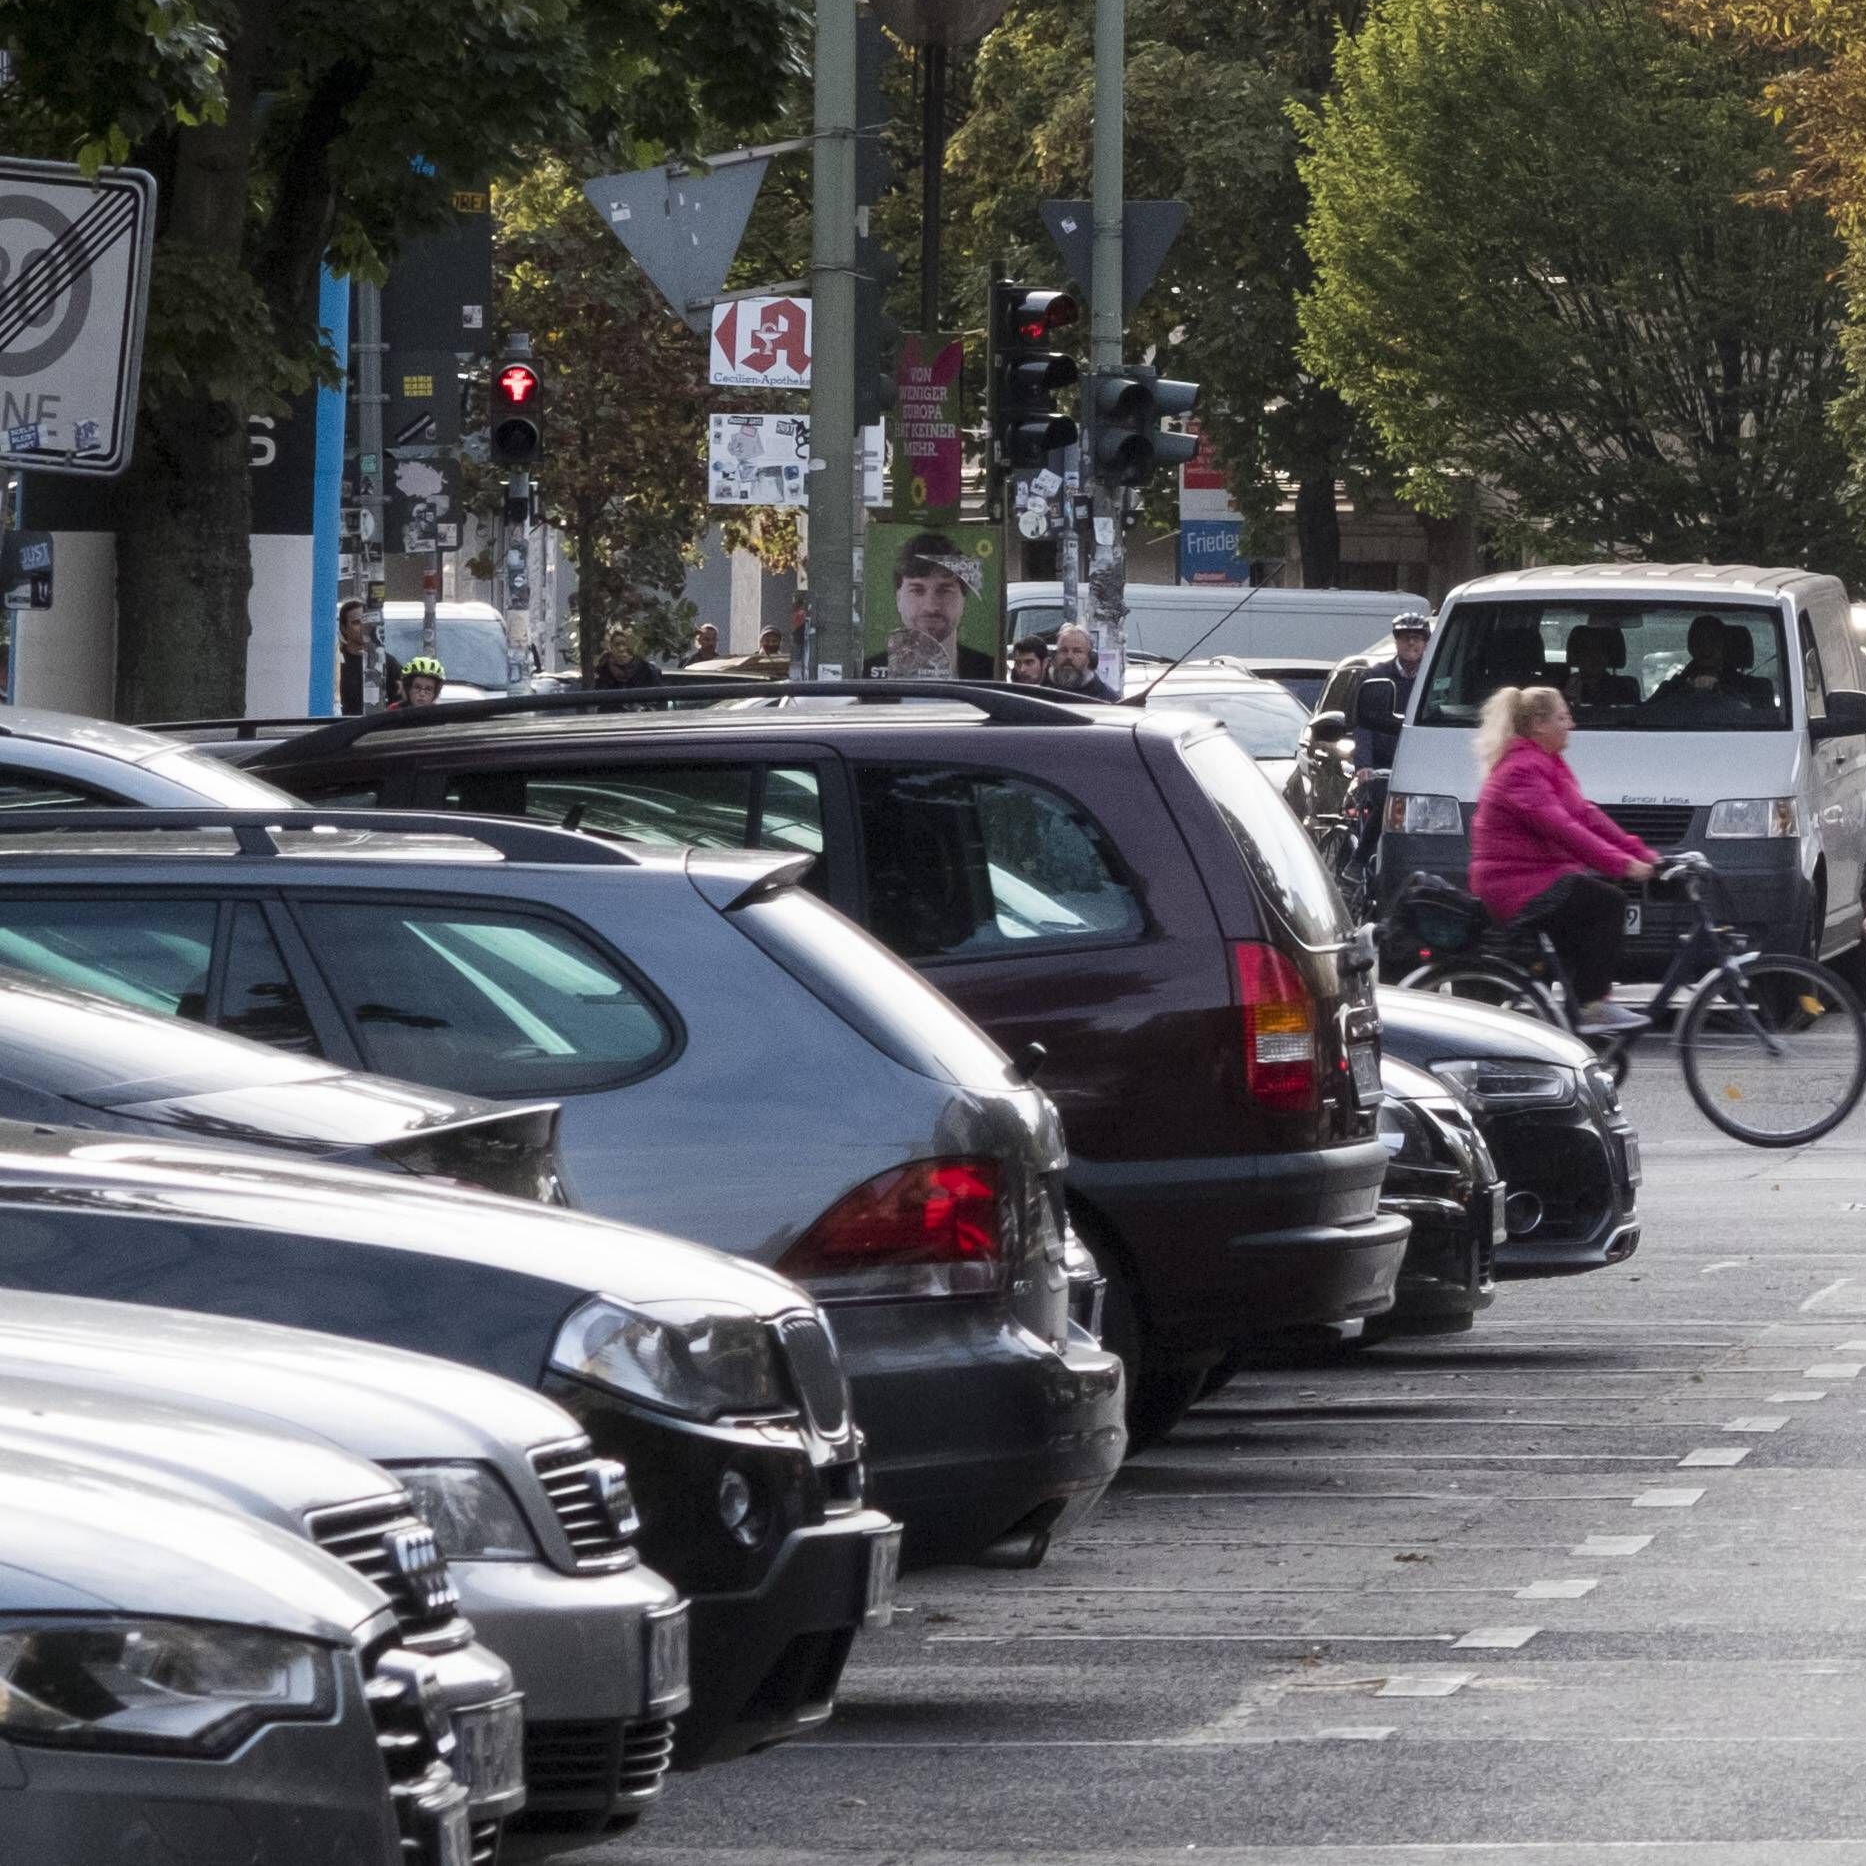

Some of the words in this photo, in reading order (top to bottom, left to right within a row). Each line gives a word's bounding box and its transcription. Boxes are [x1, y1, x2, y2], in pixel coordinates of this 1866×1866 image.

[910, 367, 932, 383] VON
[899, 386, 948, 401] WENIGER
[902, 404, 943, 420] EUROPA
[911, 422, 956, 438] KEINER
